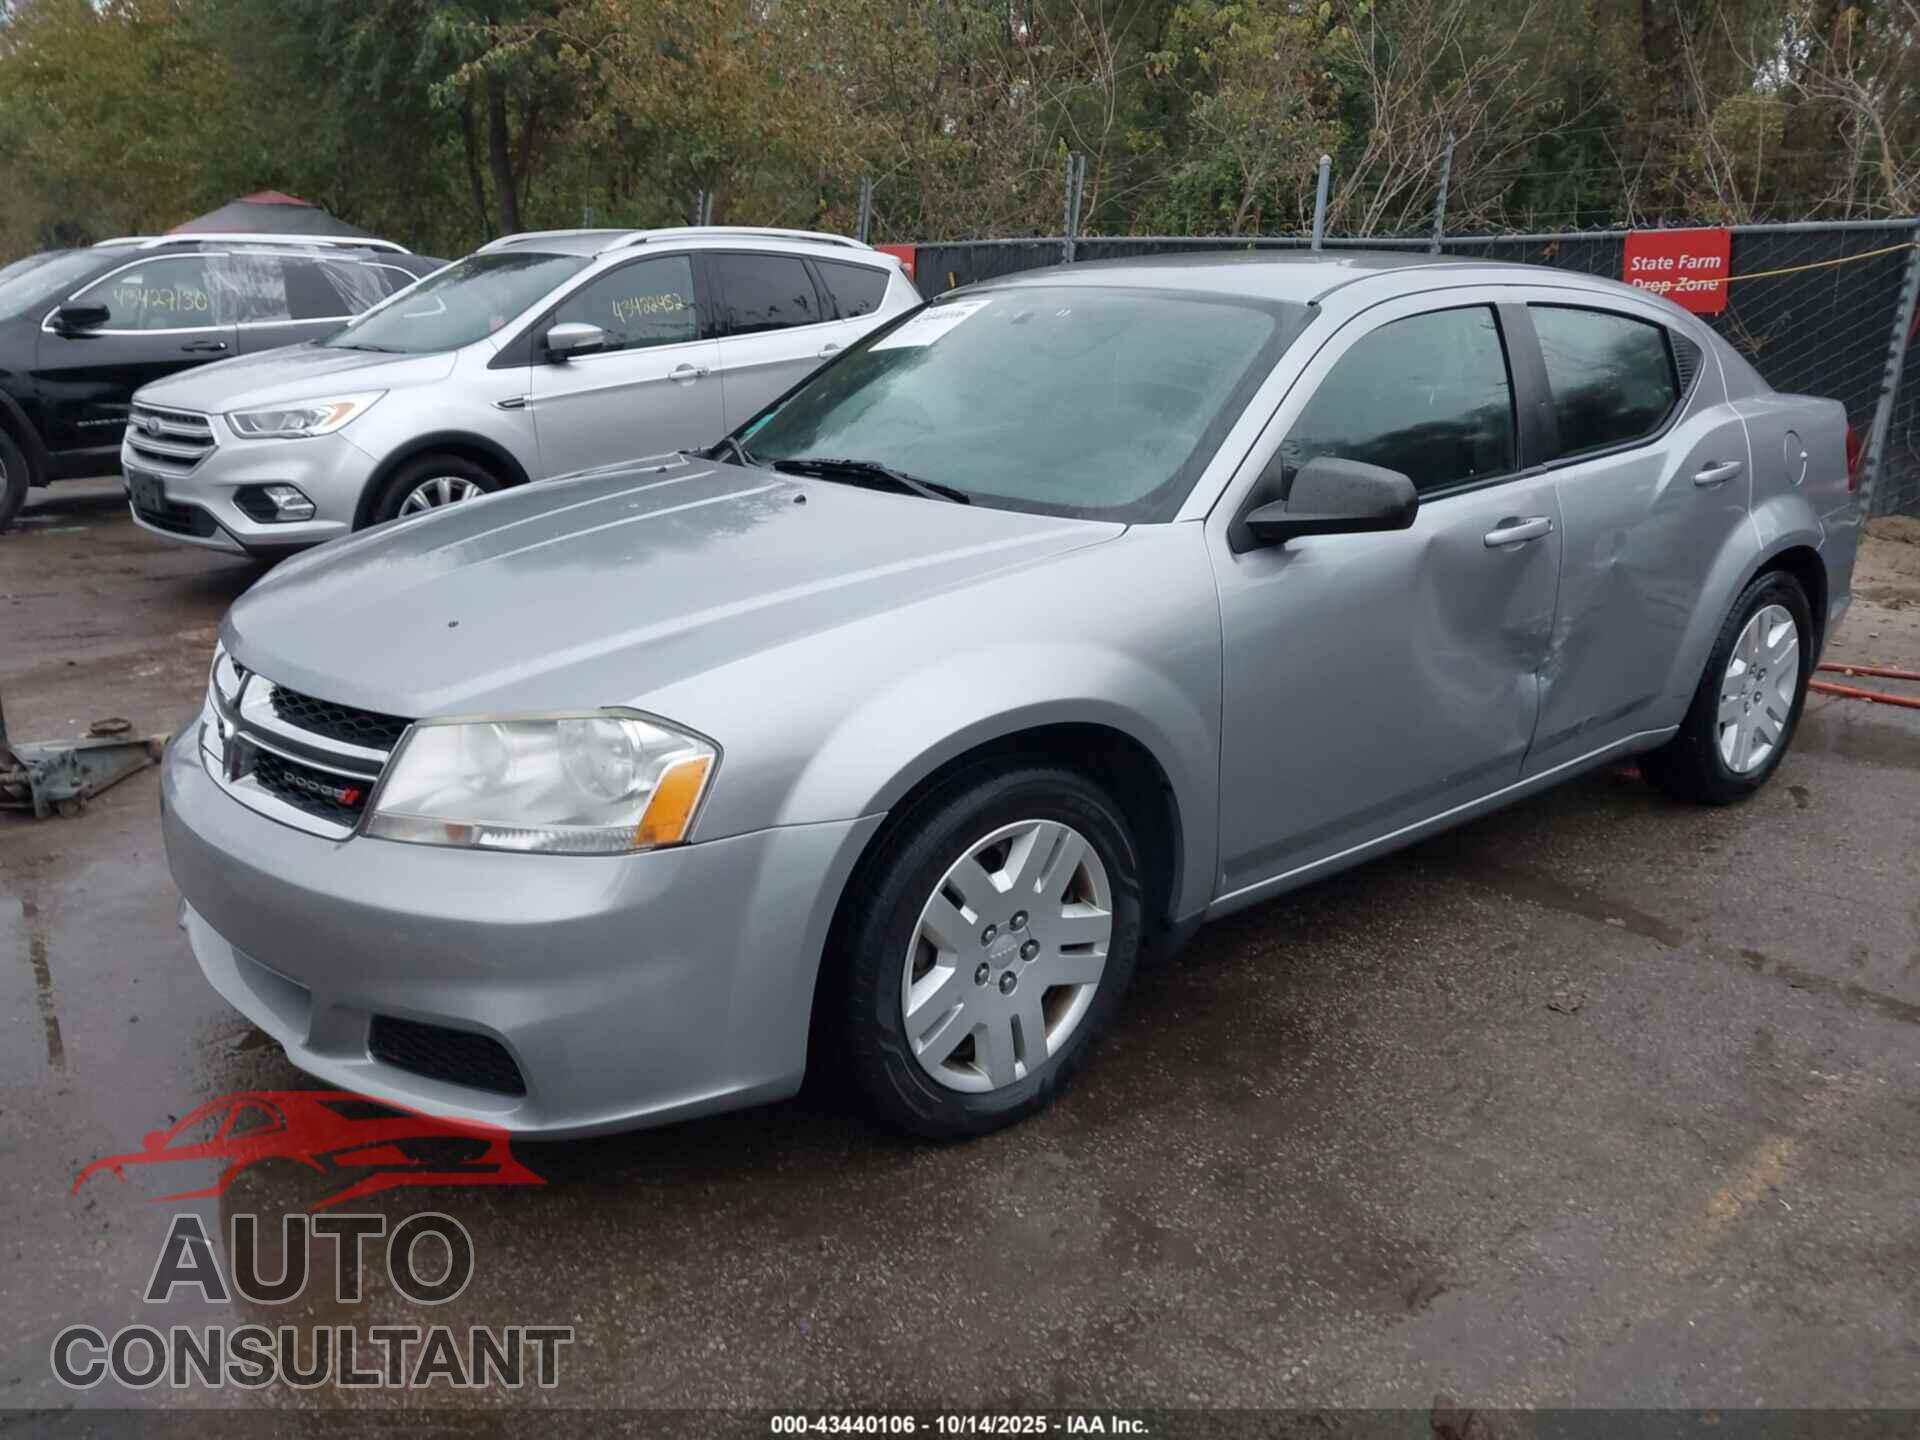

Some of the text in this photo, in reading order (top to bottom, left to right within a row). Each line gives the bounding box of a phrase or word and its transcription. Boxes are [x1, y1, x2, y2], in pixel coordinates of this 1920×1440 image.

[1631, 254, 1721, 271] State Farm
[1632, 277, 1719, 295] Drop Zone
